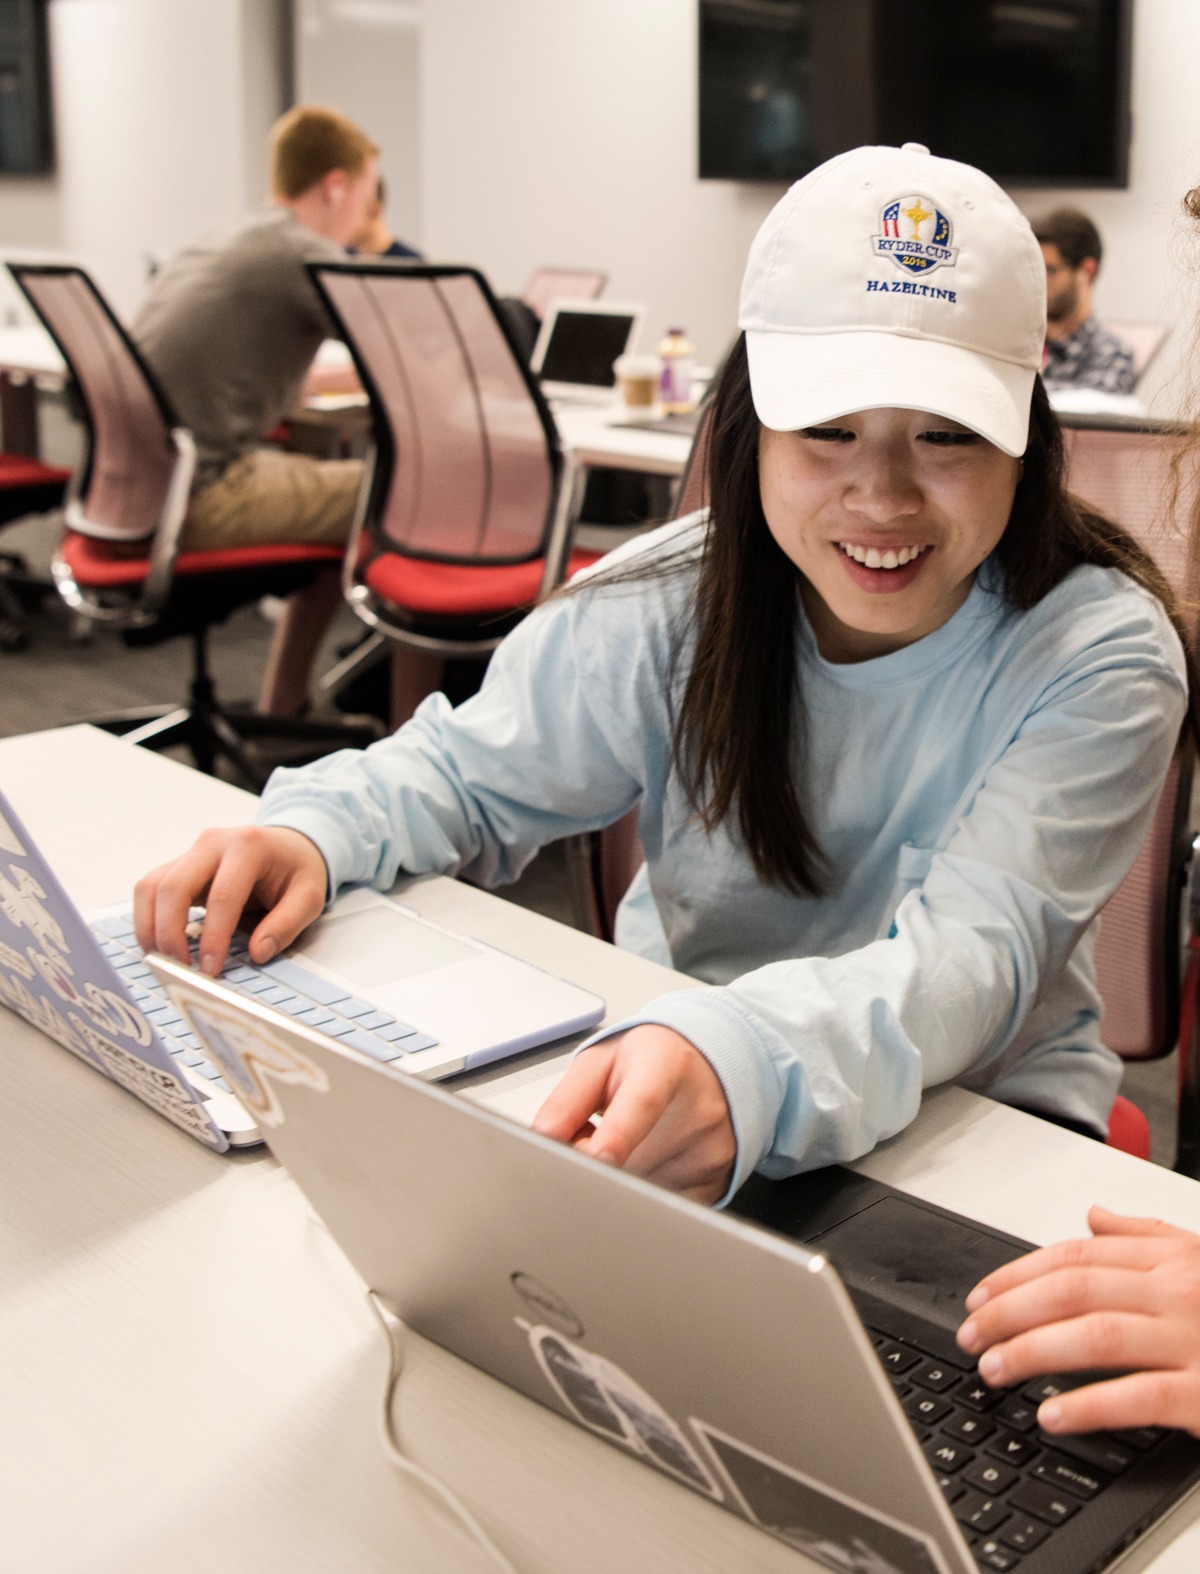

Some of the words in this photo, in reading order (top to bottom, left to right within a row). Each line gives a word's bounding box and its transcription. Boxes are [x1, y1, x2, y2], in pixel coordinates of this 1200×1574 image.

[878, 240, 925, 255] RYDER
[925, 246, 953, 260] CUP
[866, 280, 957, 303] HAZELTINE
[887, 1353, 901, 1362] V
[928, 1370, 943, 1380] C
[970, 1389, 986, 1400] X
[919, 1401, 935, 1412] D
[1008, 1440, 1022, 1451] A
[936, 1447, 956, 1461] W
[982, 1468, 999, 1481] Q
